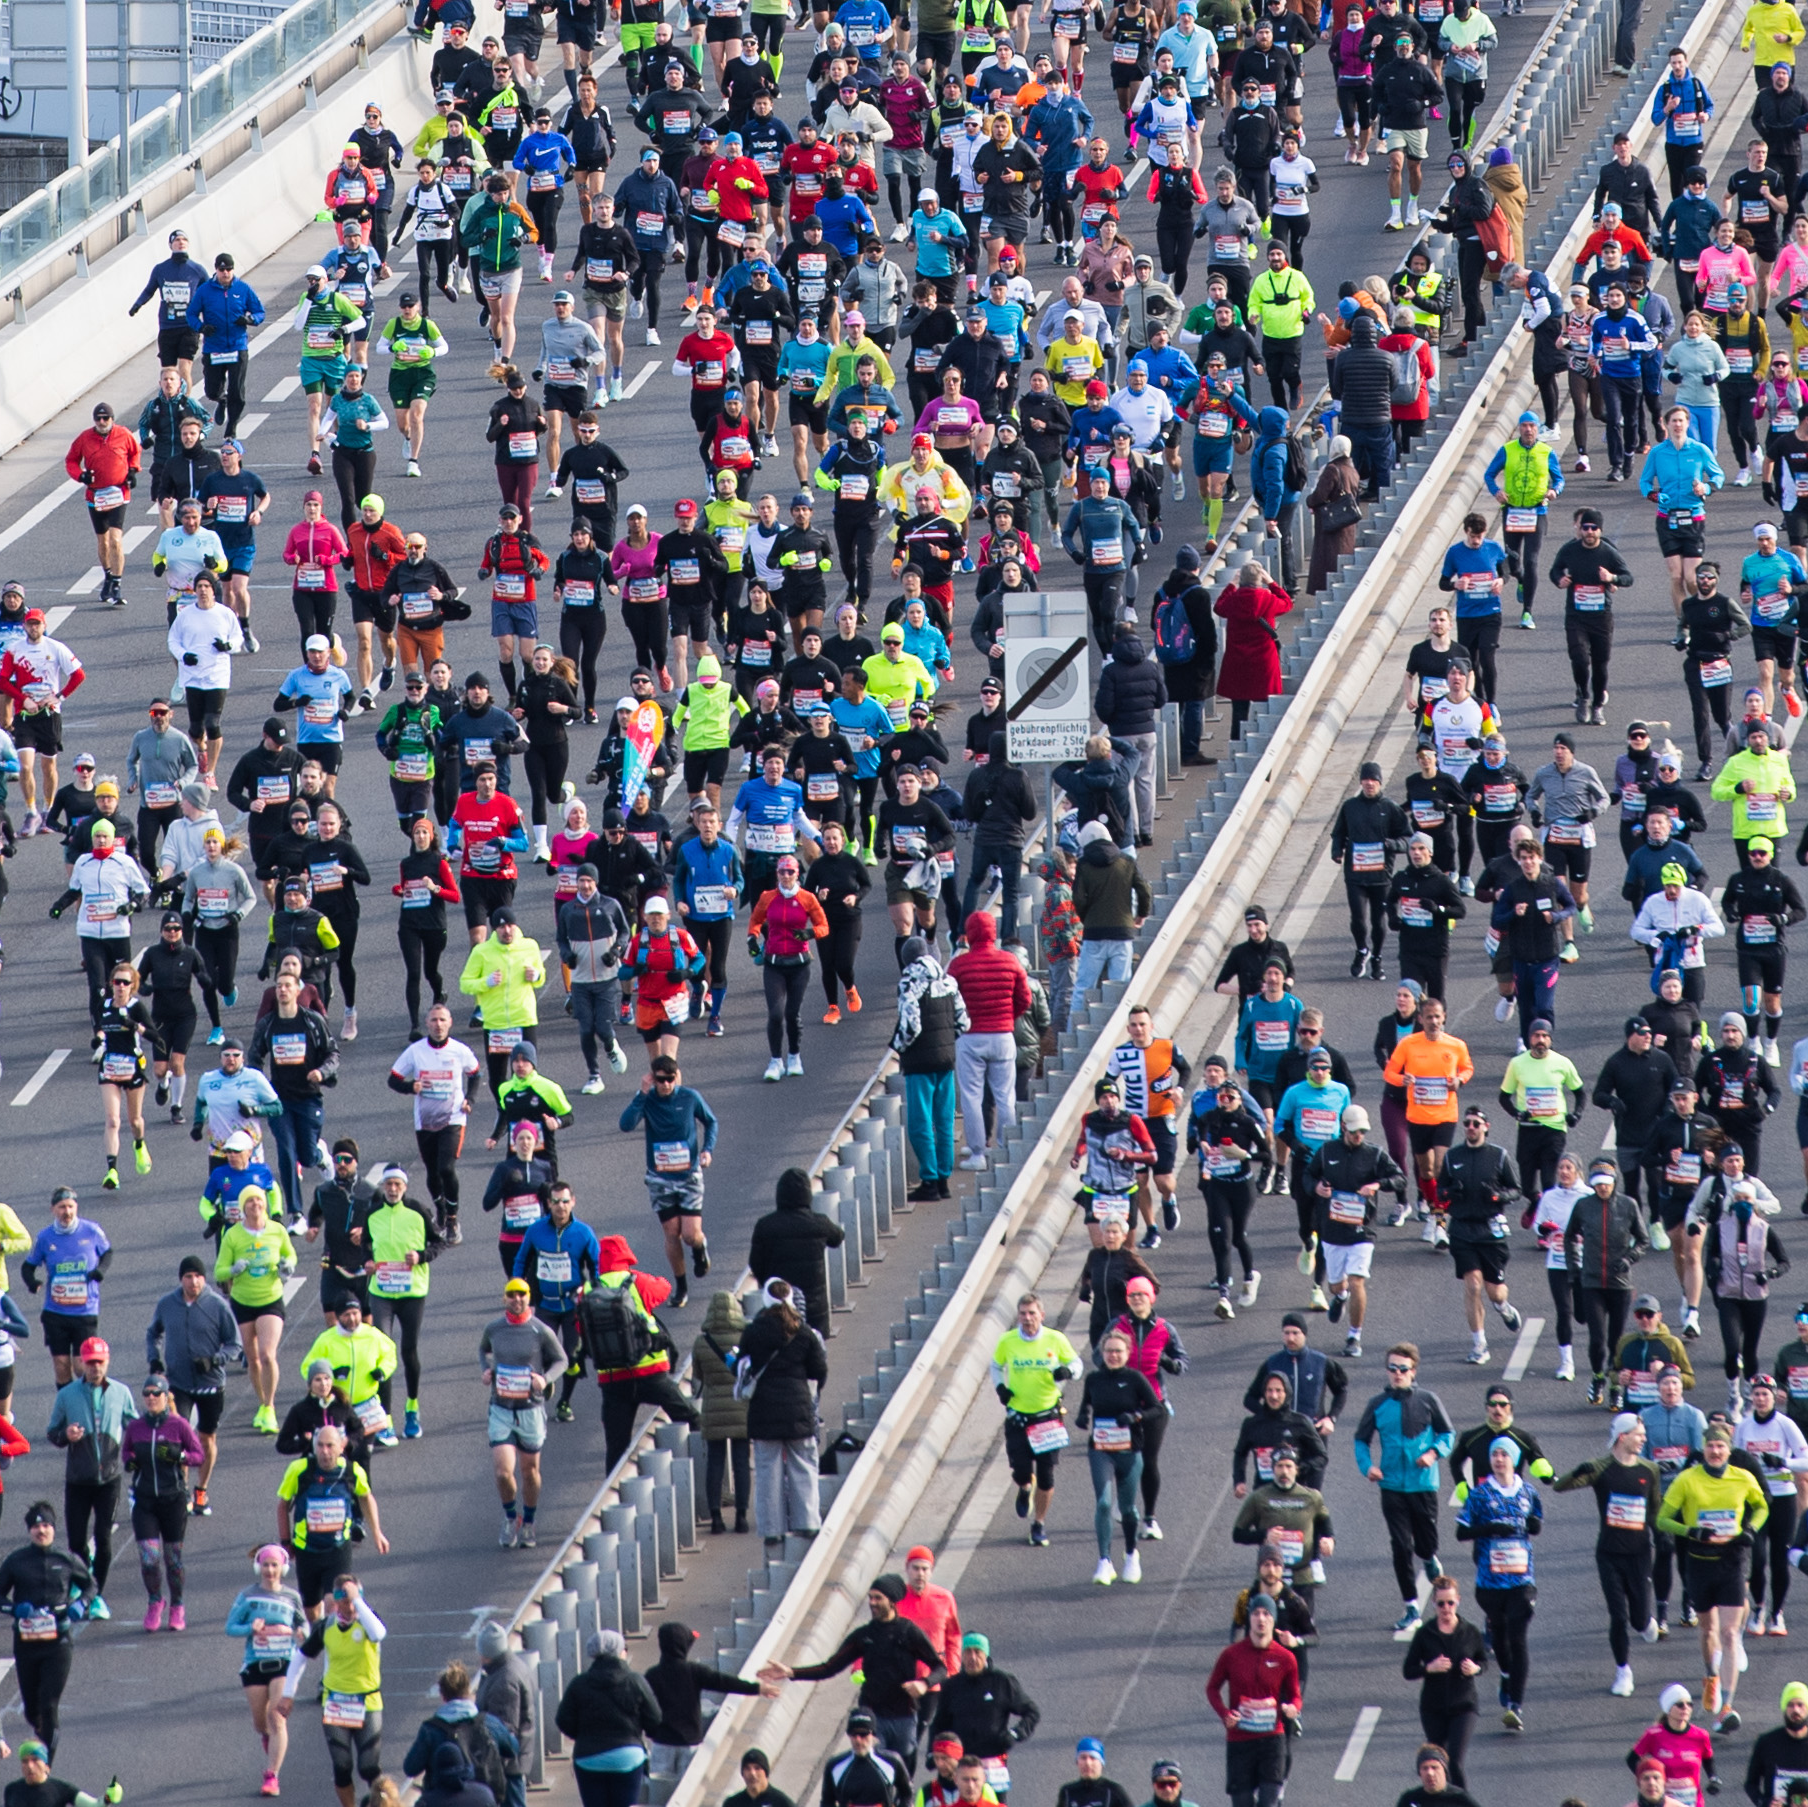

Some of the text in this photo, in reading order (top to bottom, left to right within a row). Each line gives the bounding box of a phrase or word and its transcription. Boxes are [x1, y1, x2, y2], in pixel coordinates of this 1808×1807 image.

[1010, 723, 1087, 735] gebührenpflichtig
[1011, 737, 1060, 748] Parkdauer:
[1062, 736, 1068, 746] 2
[211, 899, 226, 907] Lena
[56, 1260, 87, 1273] BERLIN
